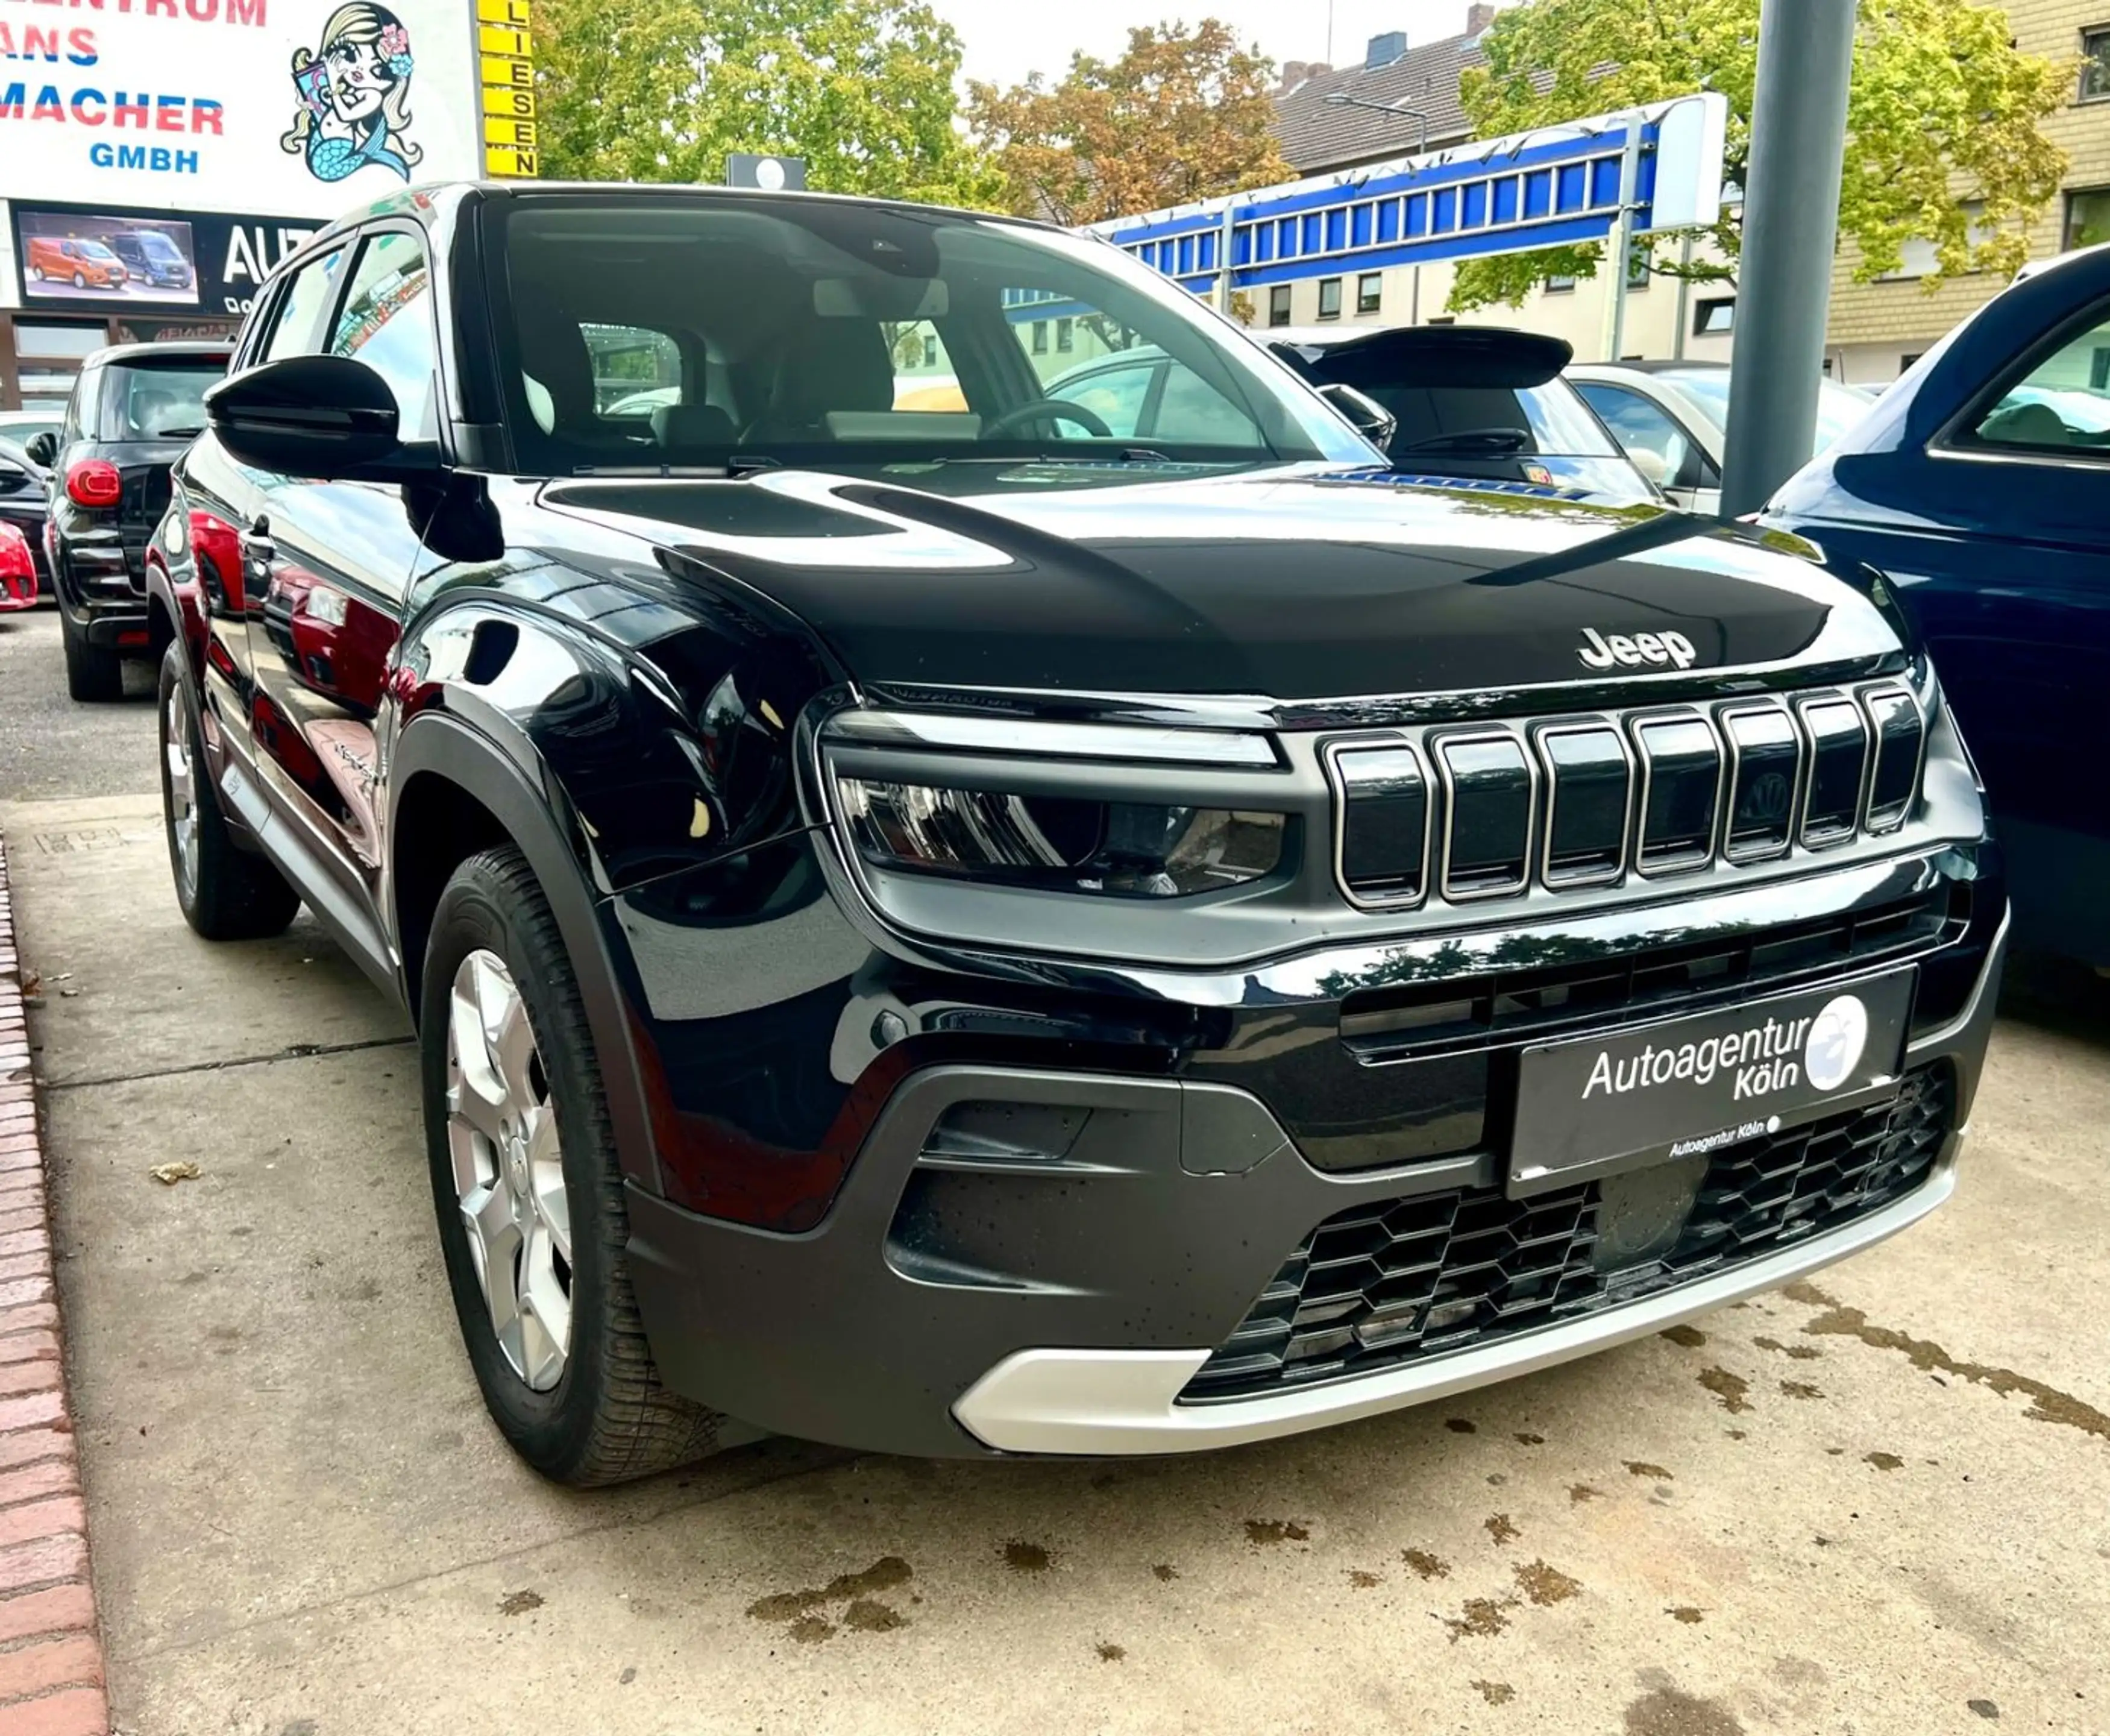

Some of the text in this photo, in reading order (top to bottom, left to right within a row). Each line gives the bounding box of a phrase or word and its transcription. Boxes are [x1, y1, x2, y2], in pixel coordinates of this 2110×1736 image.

[89, 142, 199, 174] GMBH
[1575, 627, 1696, 671] Jeep
[1581, 1016, 1810, 1099] Autoagentur
[1733, 1058, 1799, 1101] Köln
[1668, 1121, 1765, 1158] Autoagentur Köln
